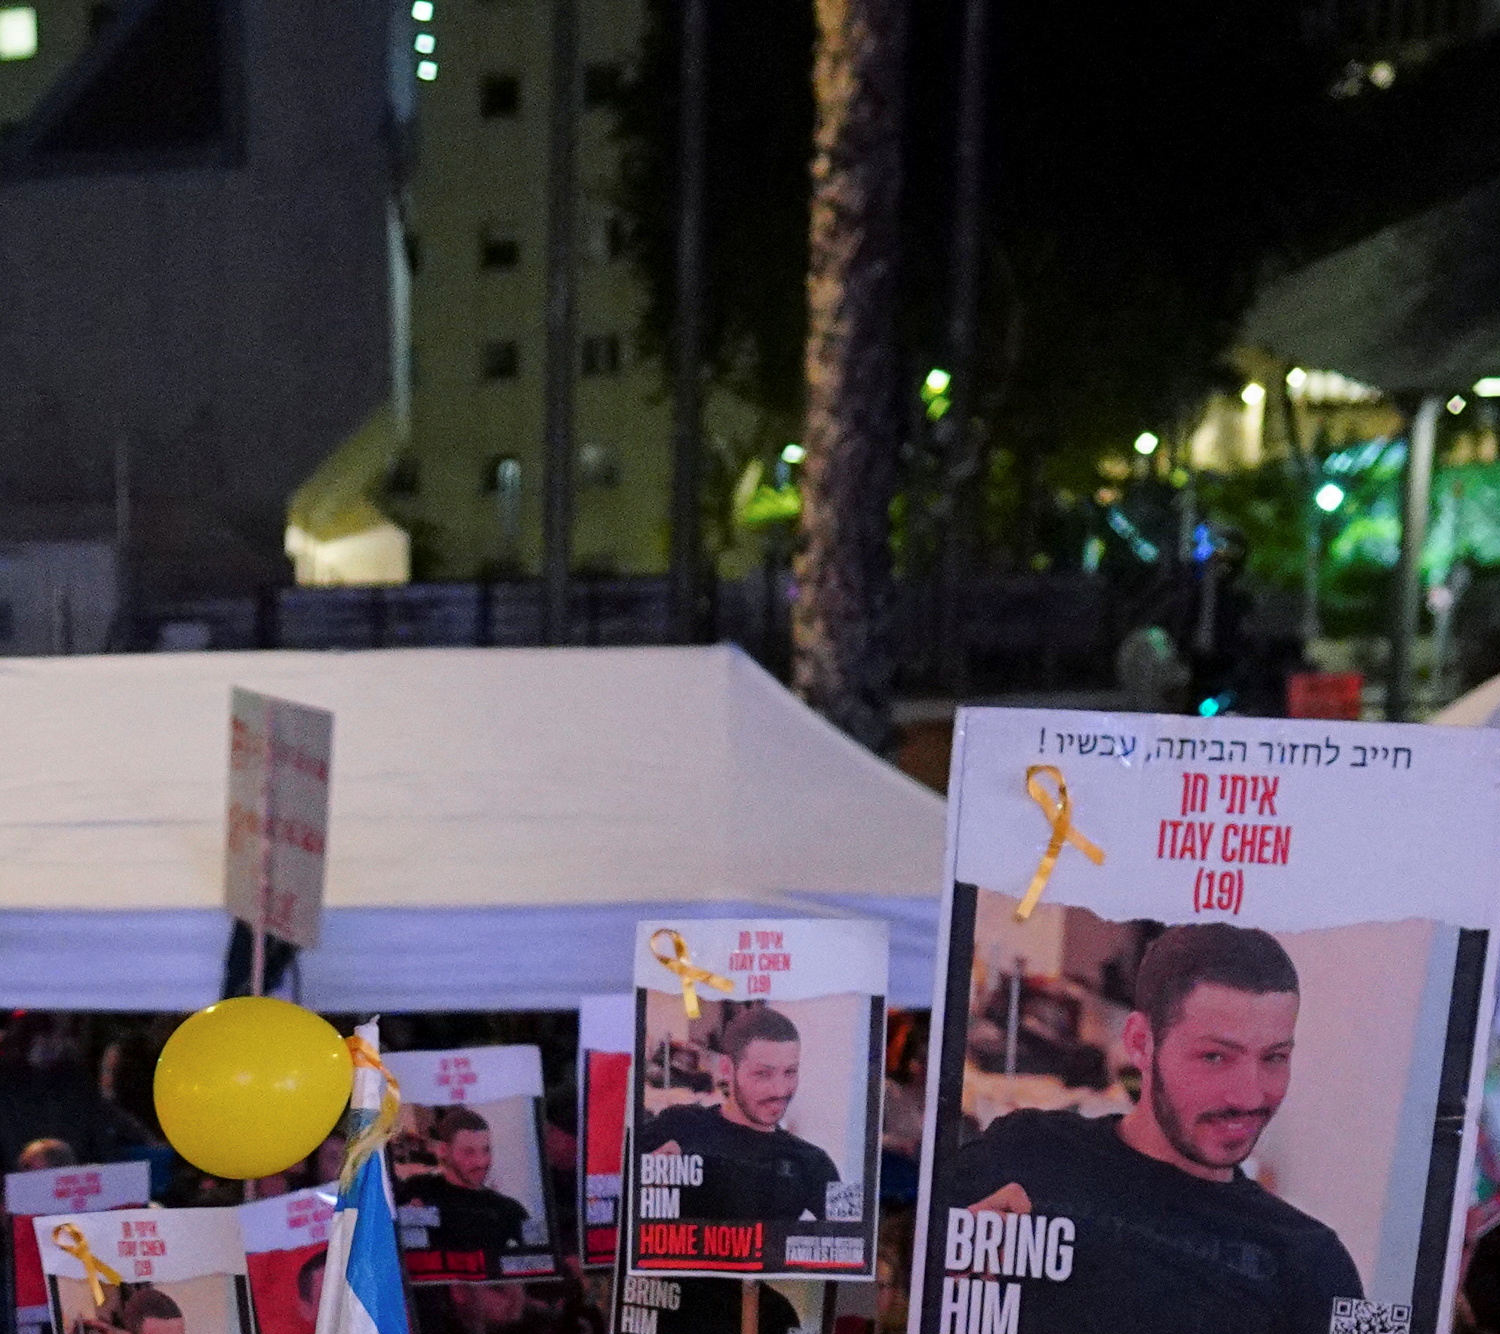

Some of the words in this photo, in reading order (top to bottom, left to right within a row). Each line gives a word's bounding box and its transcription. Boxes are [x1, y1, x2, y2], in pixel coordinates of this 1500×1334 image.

[1056, 733, 1136, 757] עכשיו
[1145, 738, 1247, 762] הביתה,
[1265, 737, 1340, 766] לחזור
[1351, 746, 1412, 769] חייב
[1181, 772, 1208, 816] חן
[1220, 775, 1278, 815] איתי
[1158, 820, 1214, 860] ITAY
[1221, 824, 1291, 864] CHEN
[1194, 868, 1243, 915] (19)
[641, 1151, 703, 1186] BRING
[945, 1208, 1074, 1280] BRING
